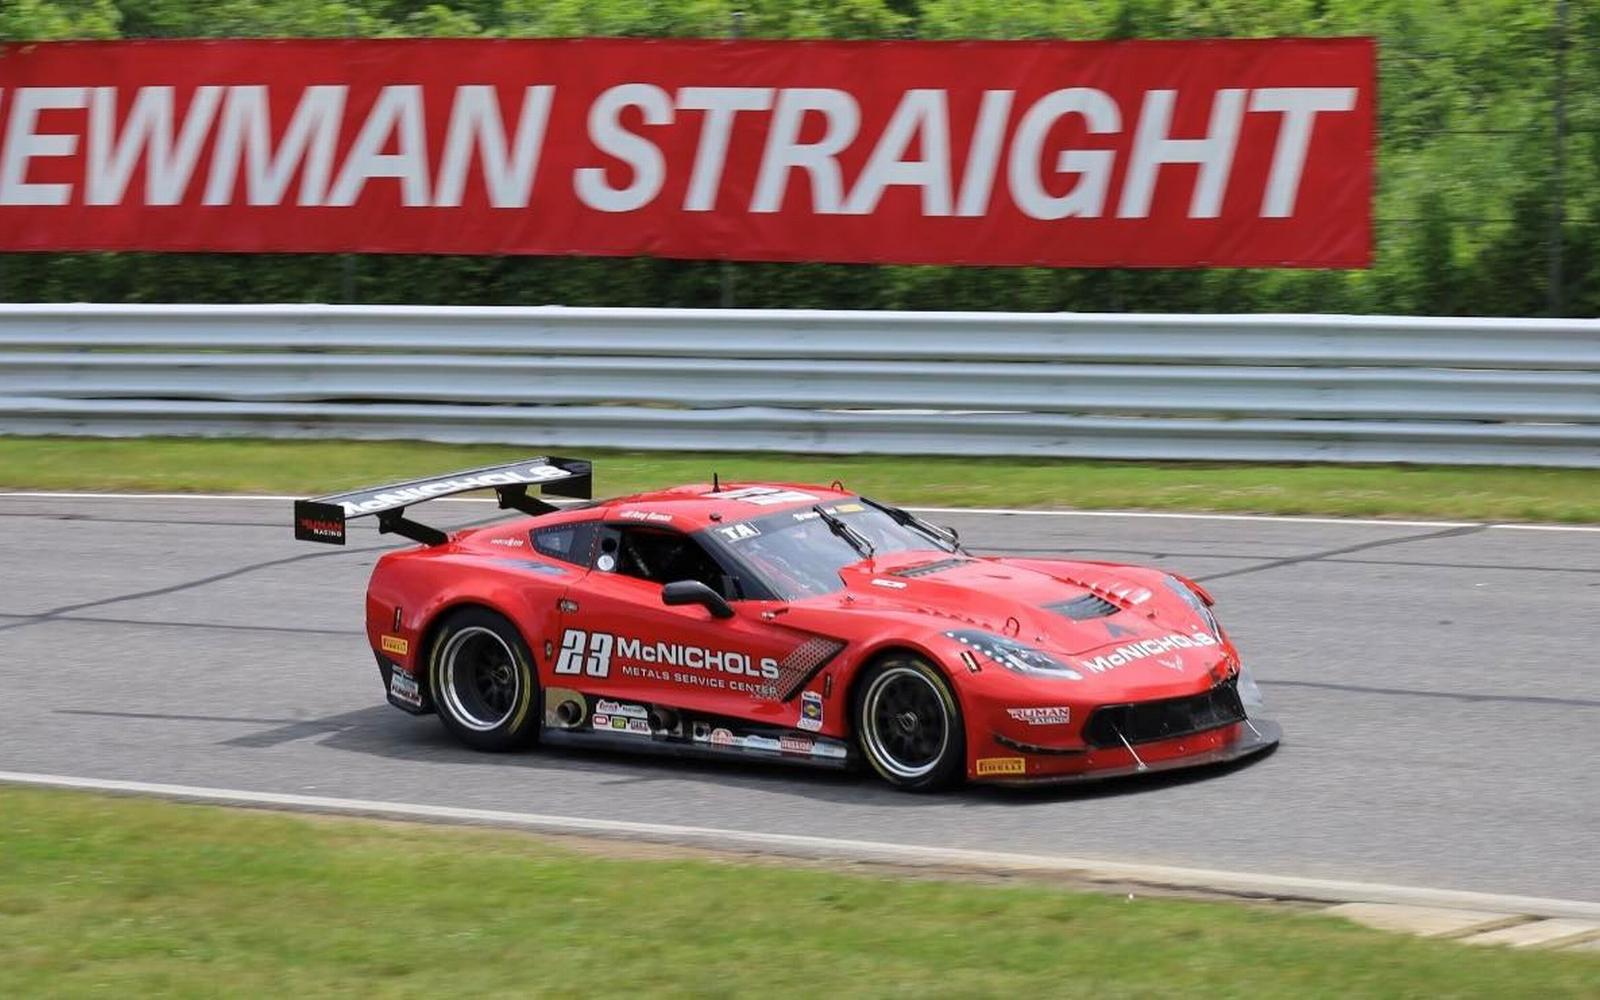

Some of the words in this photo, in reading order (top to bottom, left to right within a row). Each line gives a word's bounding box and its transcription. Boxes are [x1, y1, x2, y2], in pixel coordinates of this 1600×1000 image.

[0, 84, 556, 209] EWMAN
[573, 83, 1359, 221] STRAIGHT
[555, 629, 613, 677] 23
[617, 636, 780, 679] McNICHOLS
[1082, 631, 1217, 674] McNICHOLS
[622, 665, 670, 681] METALS
[674, 671, 725, 689] SERVICE
[729, 680, 778, 696] CENTER
